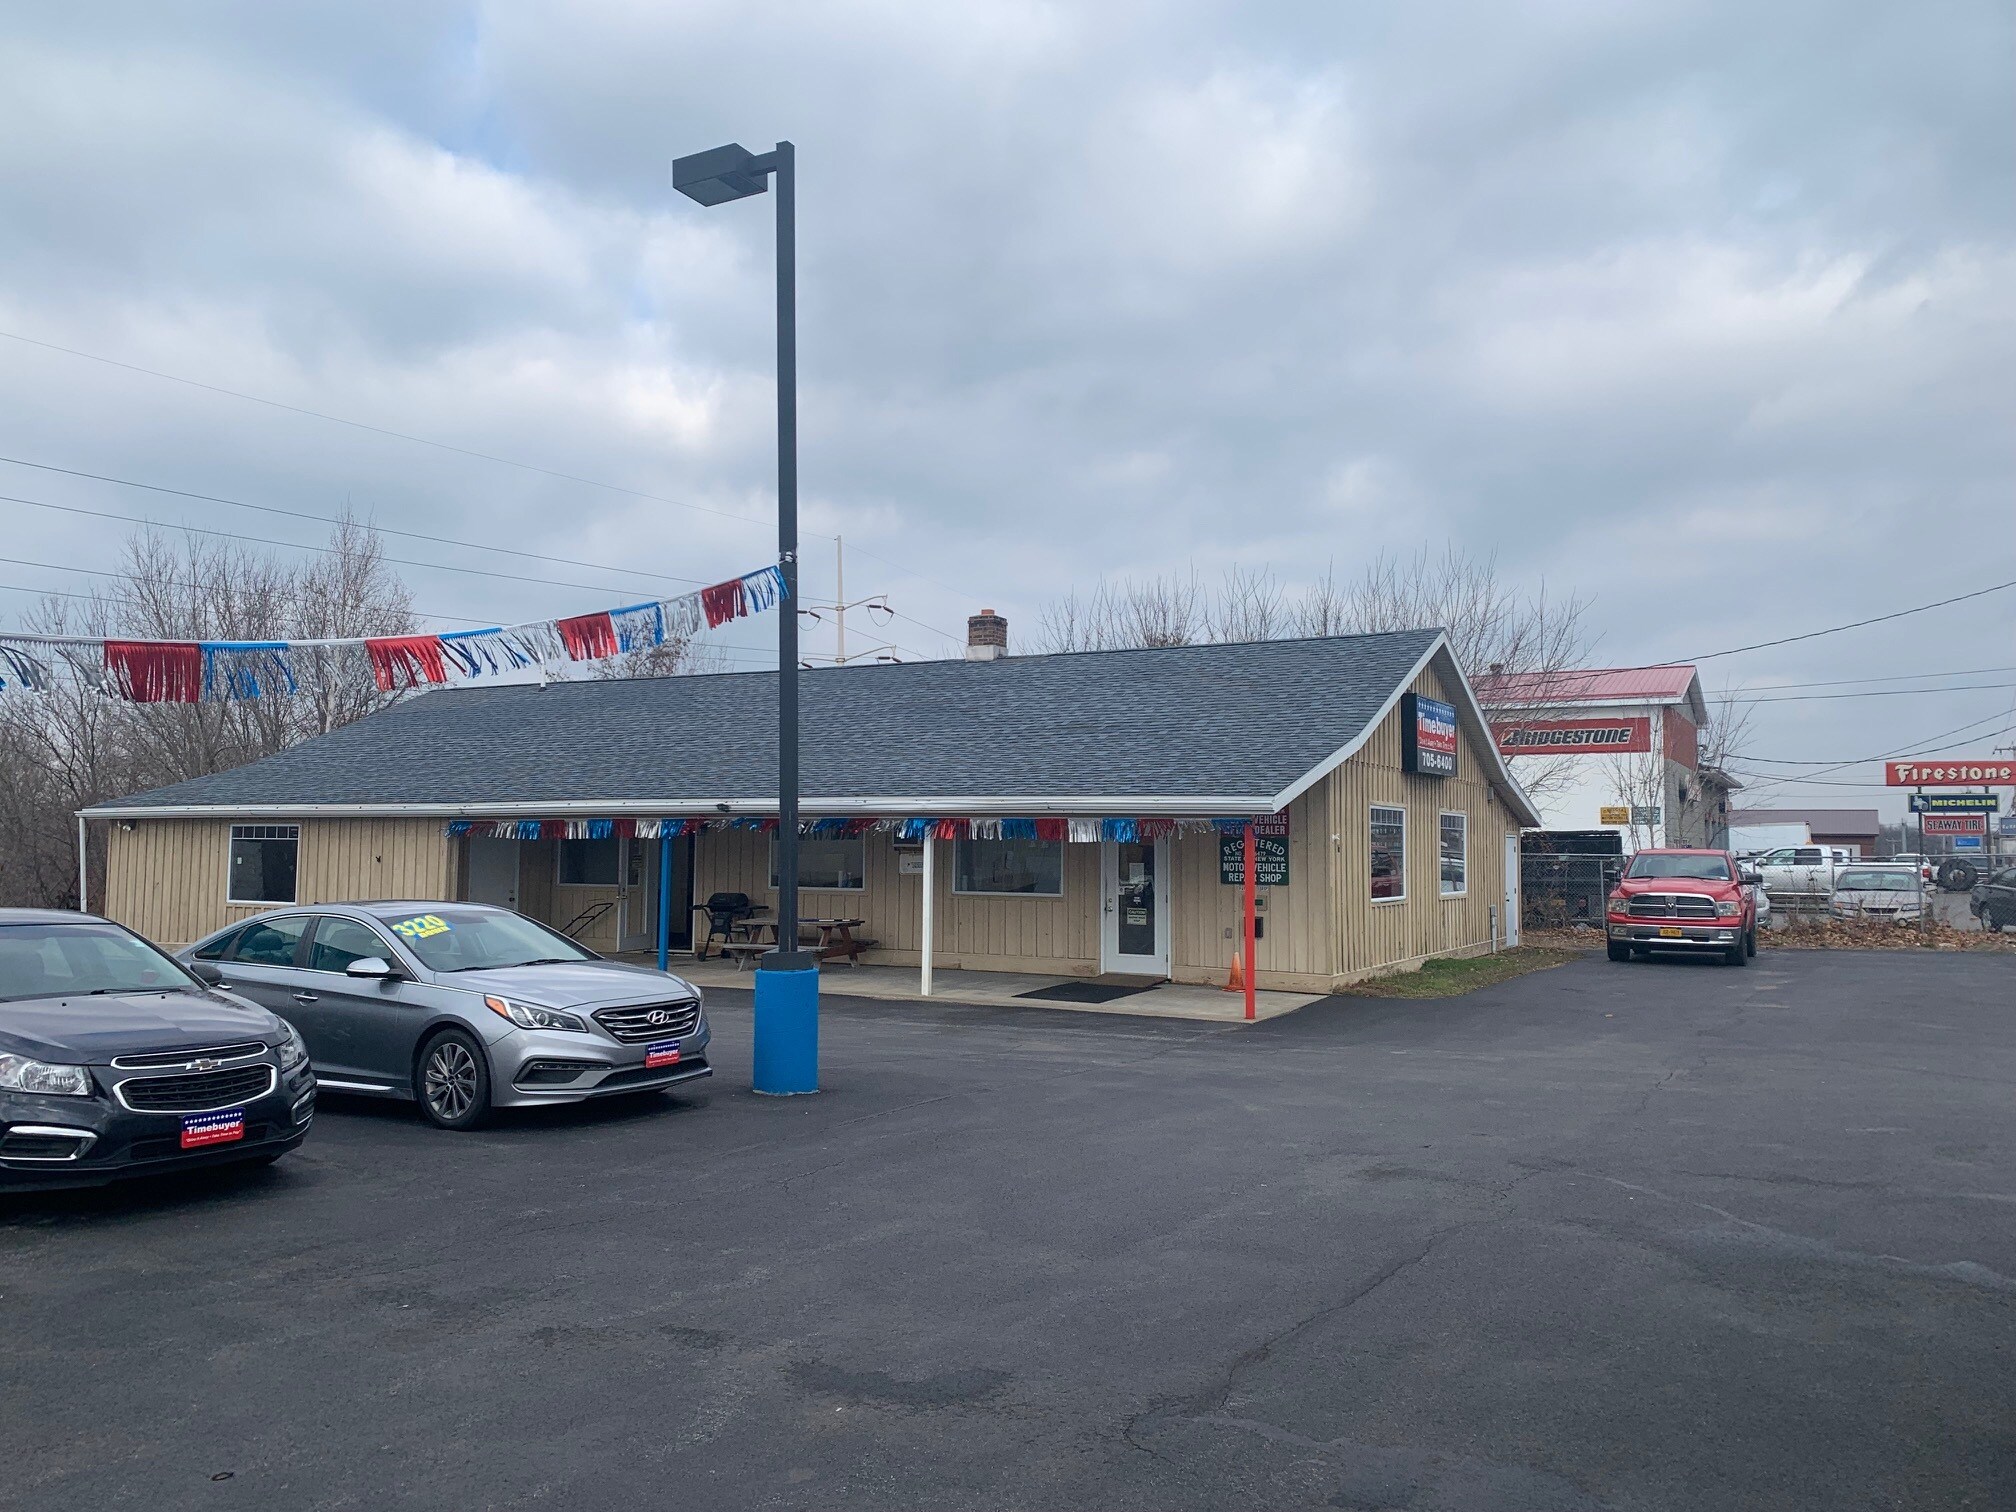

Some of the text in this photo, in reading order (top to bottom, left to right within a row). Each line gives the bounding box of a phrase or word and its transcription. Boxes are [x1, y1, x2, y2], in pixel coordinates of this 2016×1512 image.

[1418, 712, 1454, 741] Timebuyer
[1500, 728, 1632, 746] BRIDGESTONE
[1422, 752, 1452, 770] 705-6400
[1895, 764, 2012, 784] Firestone
[1927, 820, 1983, 830] SEAWAY TIRE
[1224, 839, 1284, 855] REGTERED
[1223, 863, 1245, 872] MOTO
[1260, 874, 1282, 882] SHOP
[650, 1049, 678, 1058] Timebuyer
[187, 1121, 240, 1134] Timebuyer
